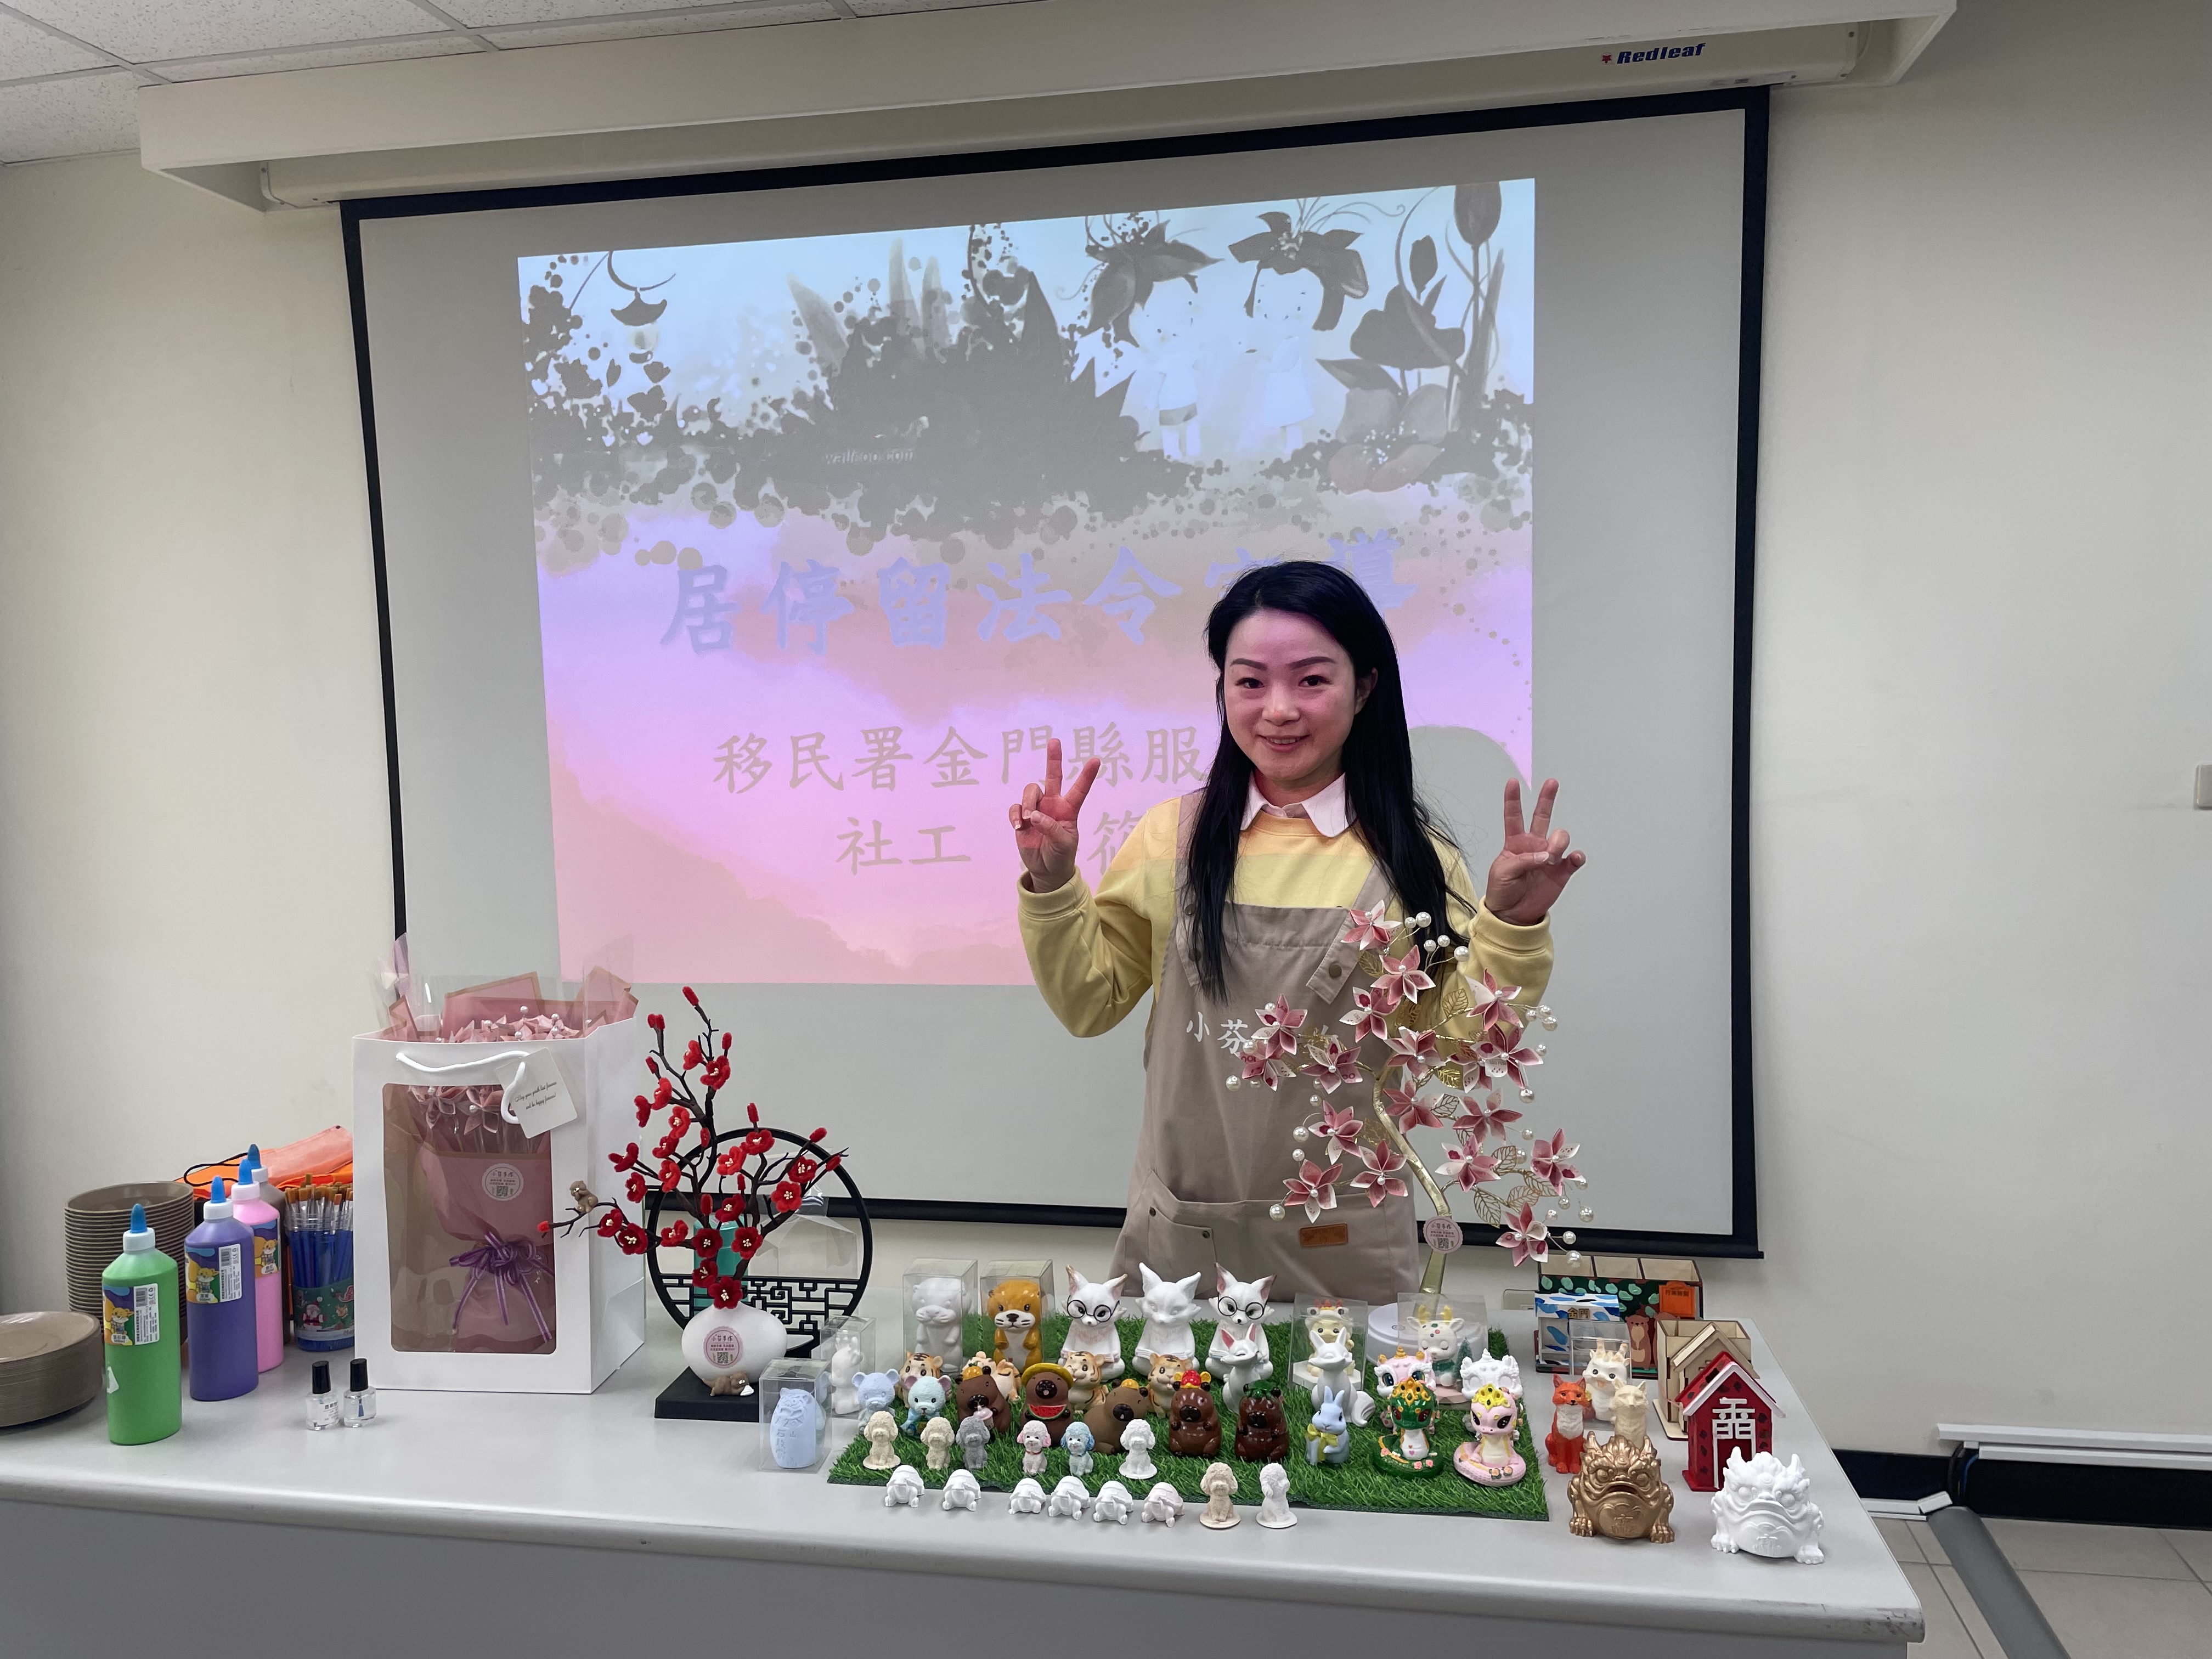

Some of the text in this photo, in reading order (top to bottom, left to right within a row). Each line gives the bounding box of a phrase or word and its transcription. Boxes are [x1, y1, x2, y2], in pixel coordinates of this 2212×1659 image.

[1617, 42, 1706, 64] Redleaf
[659, 528, 1419, 656] 居停留法令導
[1186, 1011, 1249, 1054] 小芬
